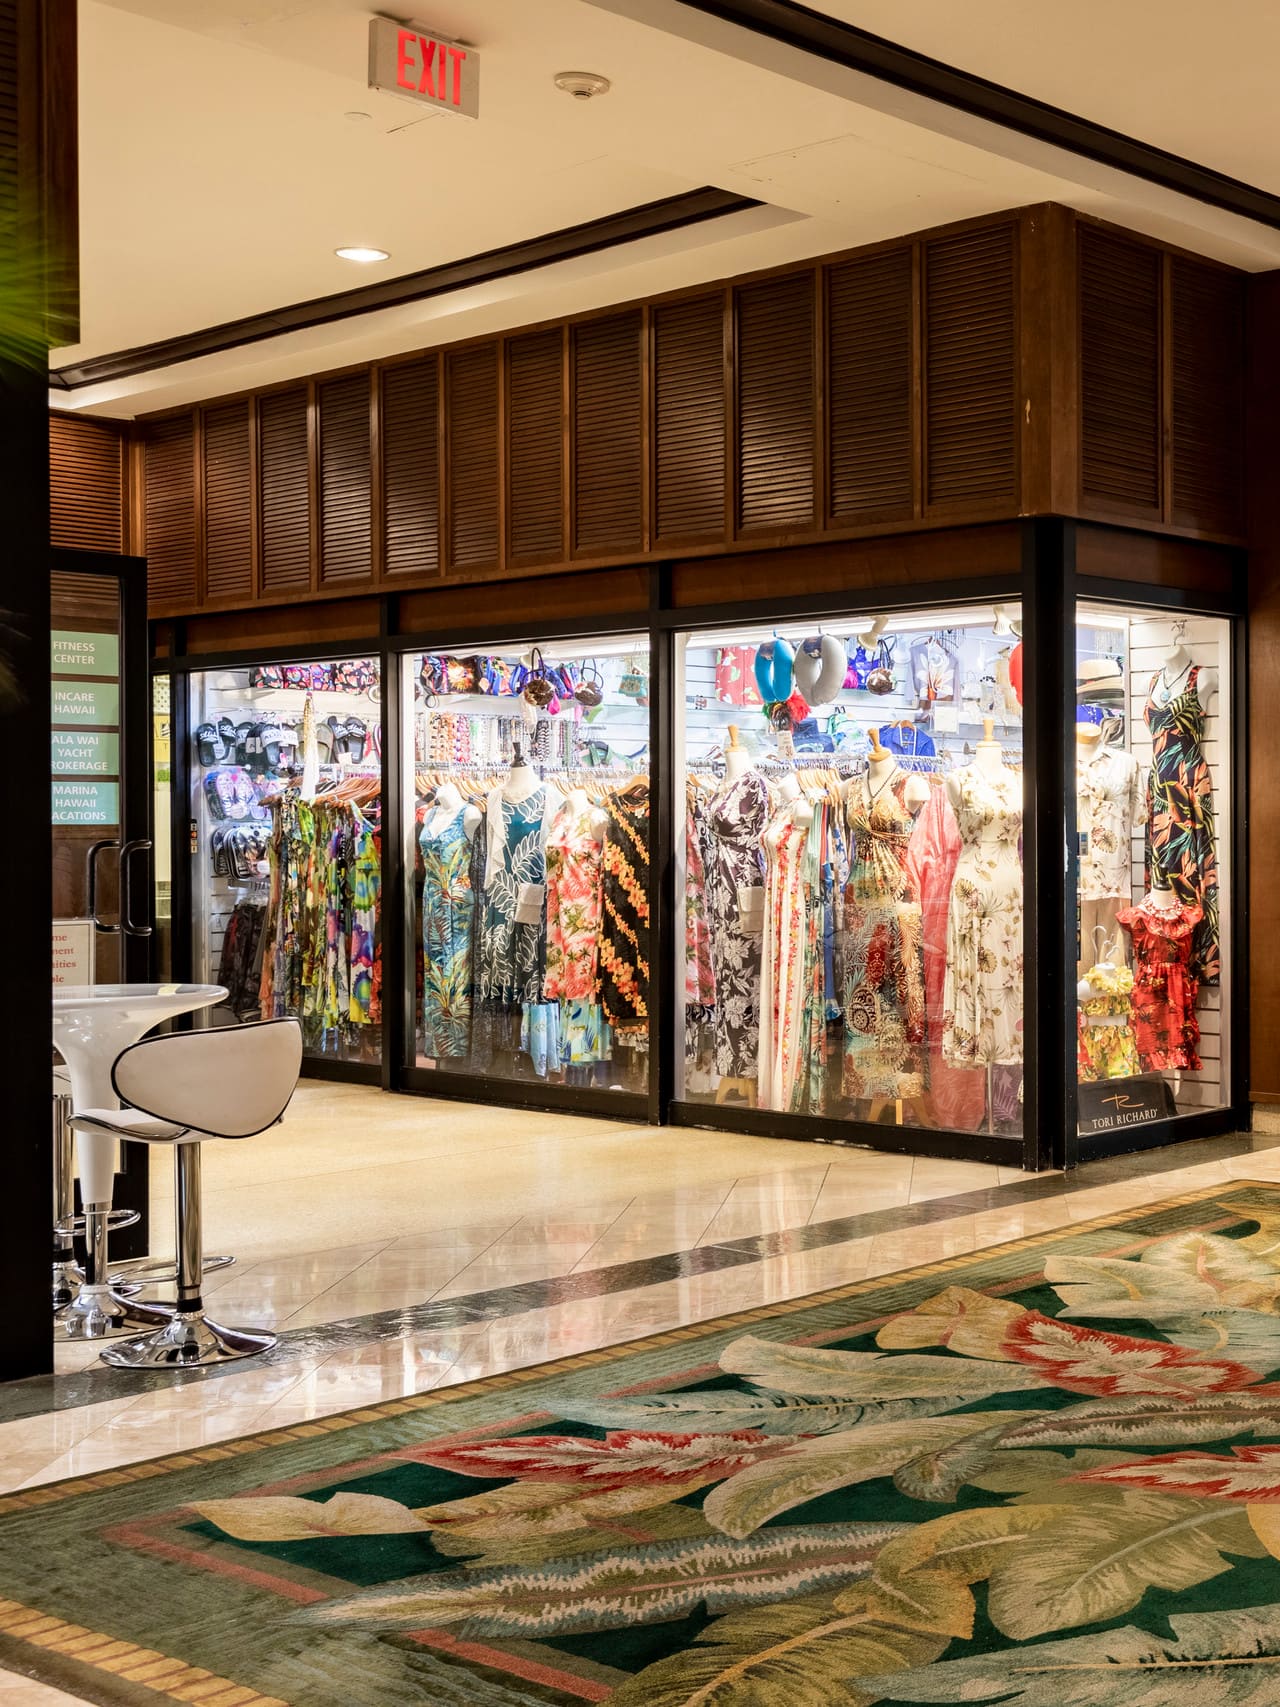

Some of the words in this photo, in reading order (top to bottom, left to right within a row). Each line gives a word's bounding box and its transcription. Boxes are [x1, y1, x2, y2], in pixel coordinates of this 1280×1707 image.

[397, 28, 466, 106] EXIT
[53, 640, 96, 652] FITNESS
[54, 653, 96, 665] CENTER
[55, 691, 96, 702] INCARE
[54, 703, 96, 715] HAWAII
[76, 736, 100, 745] WAI
[58, 748, 95, 758] YACHT
[51, 760, 109, 771] ROKERAGE
[53, 785, 98, 796] MARINA
[55, 798, 97, 808] HAWAII
[51, 811, 107, 821] ACATIONS
[1092, 1116, 1114, 1129] TORI
[1116, 1108, 1158, 1125] RICHARD
